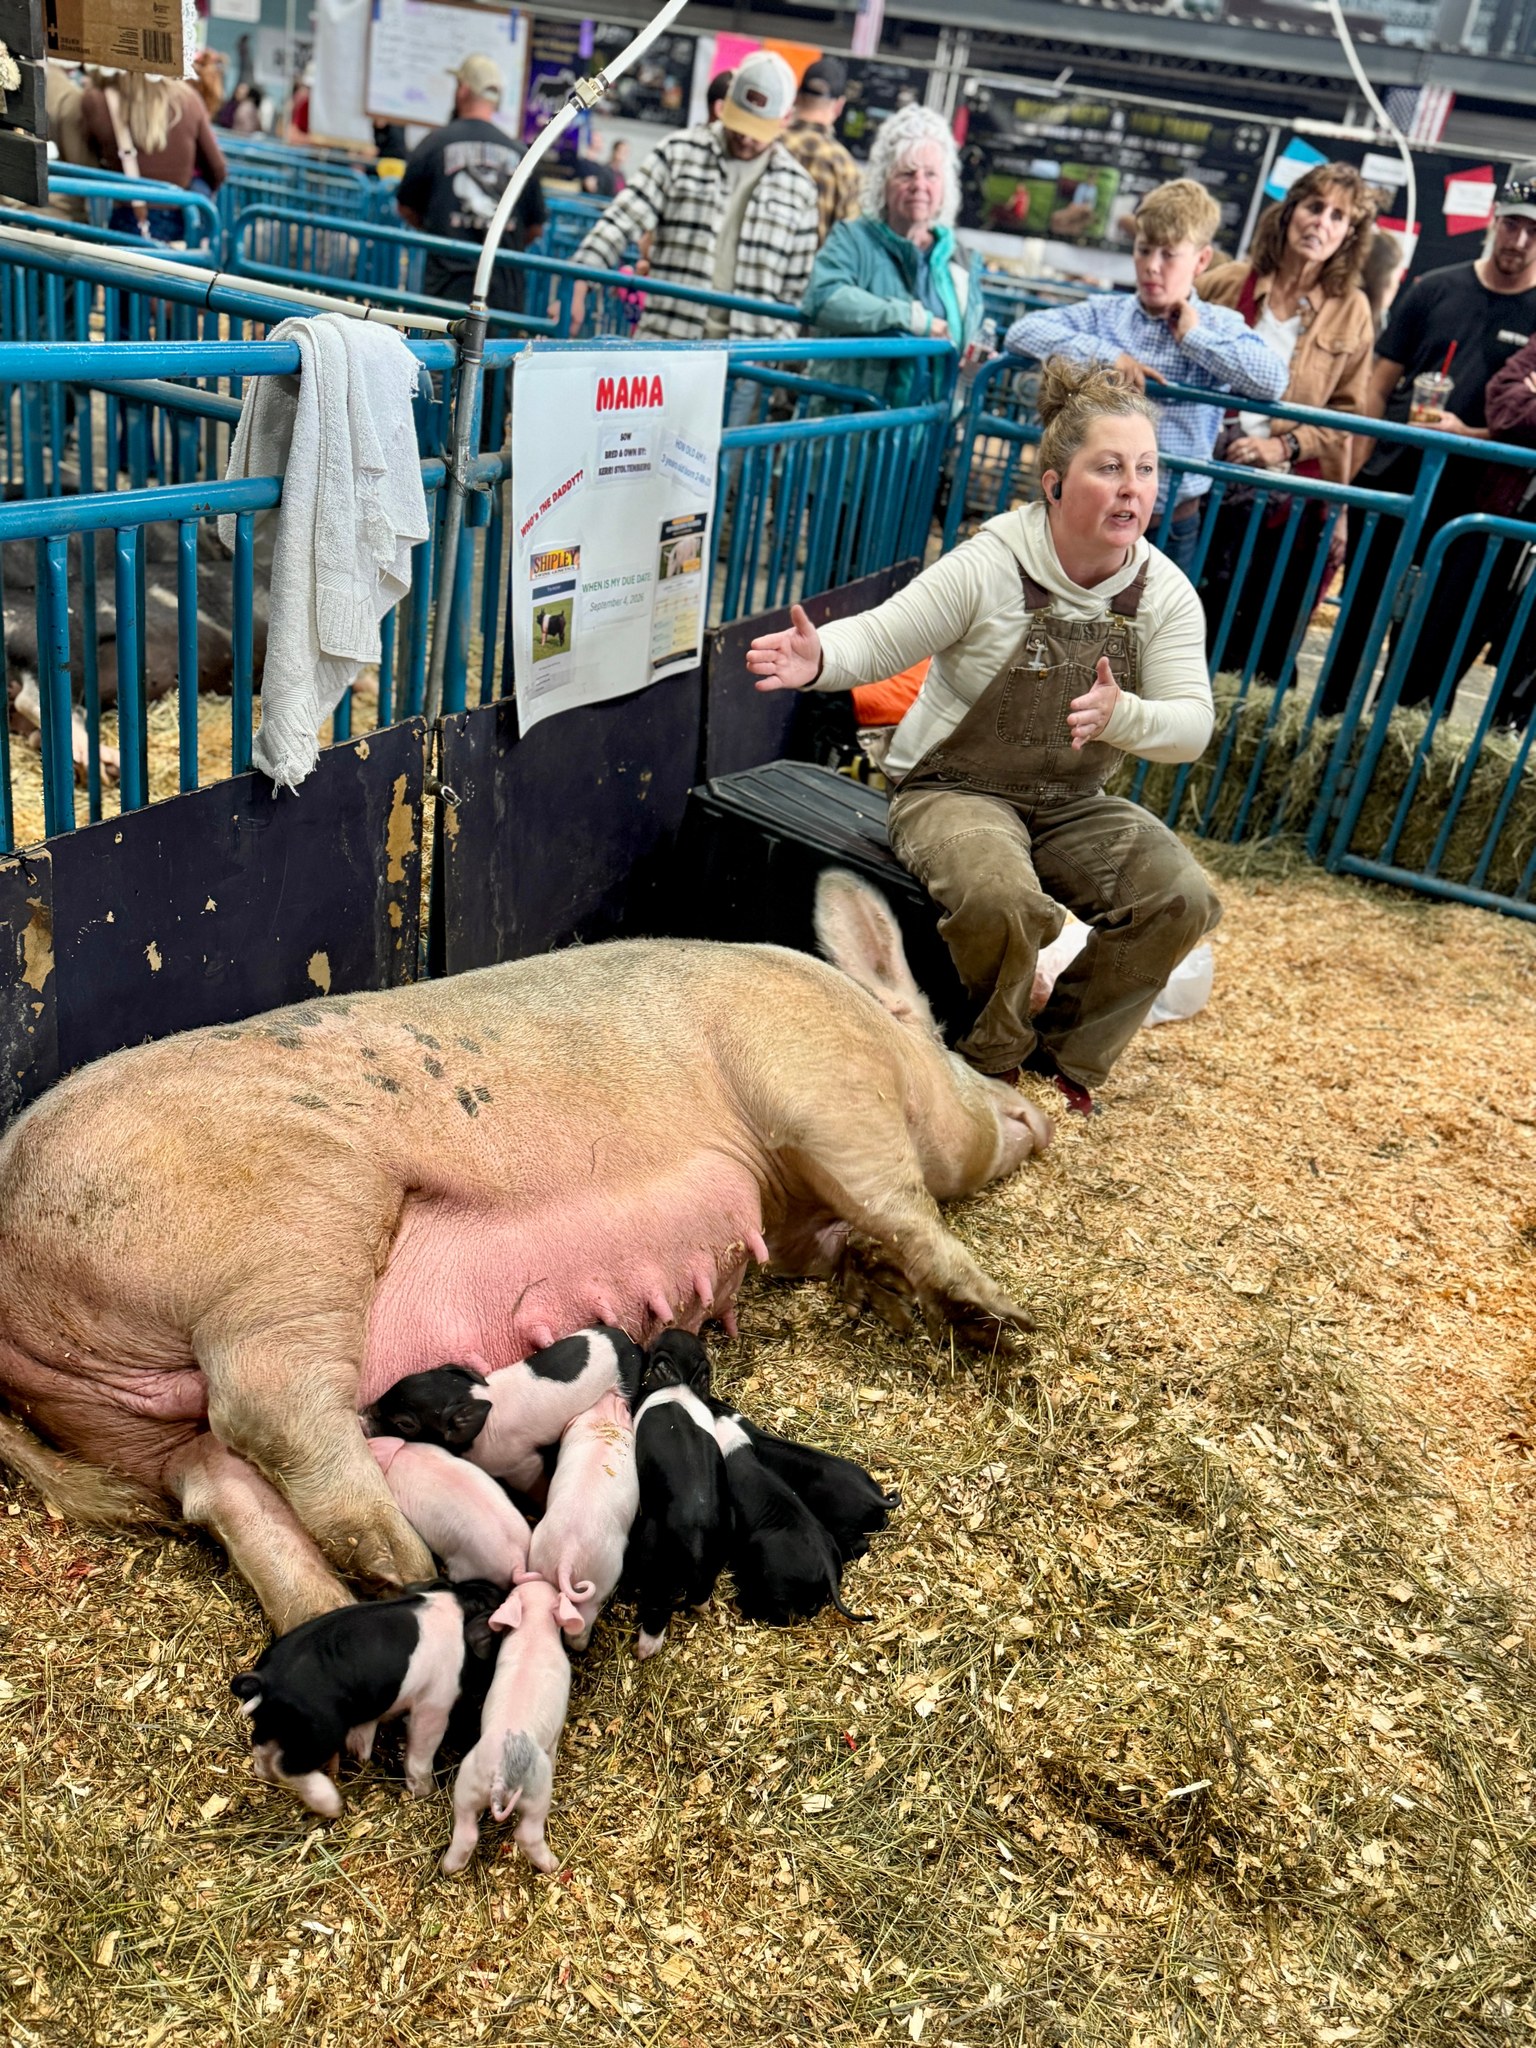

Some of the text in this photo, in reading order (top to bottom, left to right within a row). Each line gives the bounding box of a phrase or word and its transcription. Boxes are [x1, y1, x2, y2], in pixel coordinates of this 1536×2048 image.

[596, 375, 664, 412] MAMA
[620, 432, 632, 441] SOW
[605, 450, 618, 459] BRED
[624, 448, 637, 457] OWN
[685, 445, 696, 458] OLD
[661, 453, 666, 463] 3
[664, 457, 678, 470] years
[539, 497, 552, 515] THE
[534, 549, 577, 574] SHIPLEY
[581, 580, 603, 593] WHEN
[604, 580, 610, 589] IS
[611, 577, 620, 588] MY
[622, 575, 636, 586] DUE
[590, 597, 623, 612] September
